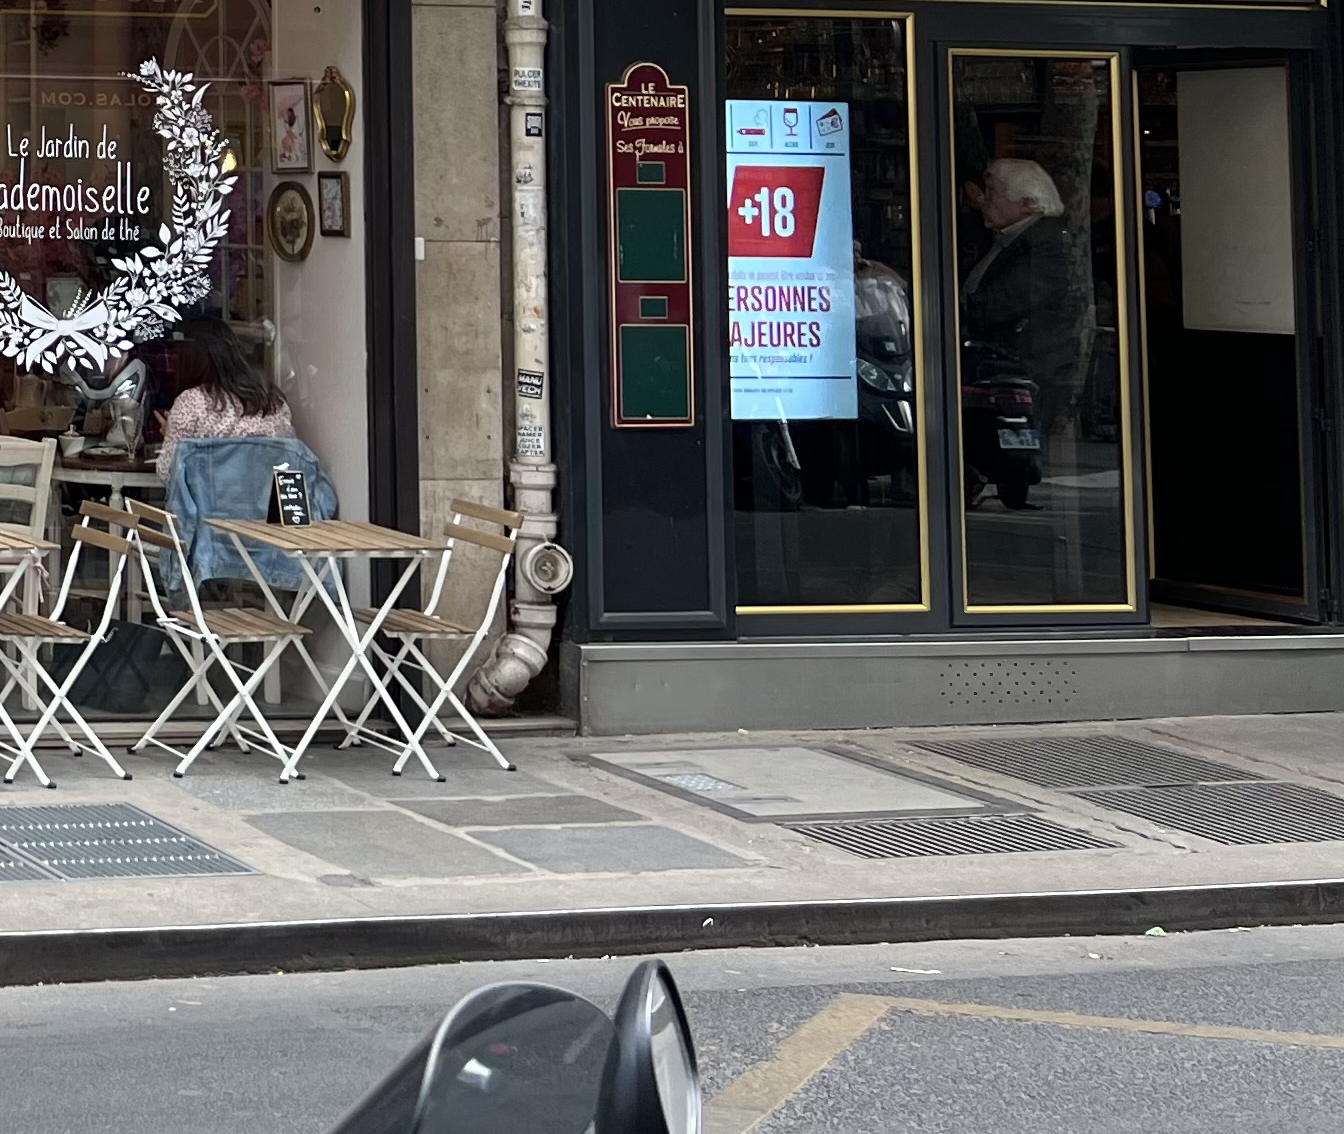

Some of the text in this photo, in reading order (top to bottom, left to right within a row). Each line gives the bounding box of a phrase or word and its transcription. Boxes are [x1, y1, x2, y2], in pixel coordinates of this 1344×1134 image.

[641, 83, 656, 94] LE
[612, 92, 685, 107] CENTENAIRE
[617, 111, 644, 127] Vous
[6, 123, 117, 160] Le Jardin de
[738, 186, 796, 238] +18
[49, 220, 62, 239] et
[66, 219, 98, 240] Salon
[102, 220, 115, 240] de
[119, 220, 140, 242] thé
